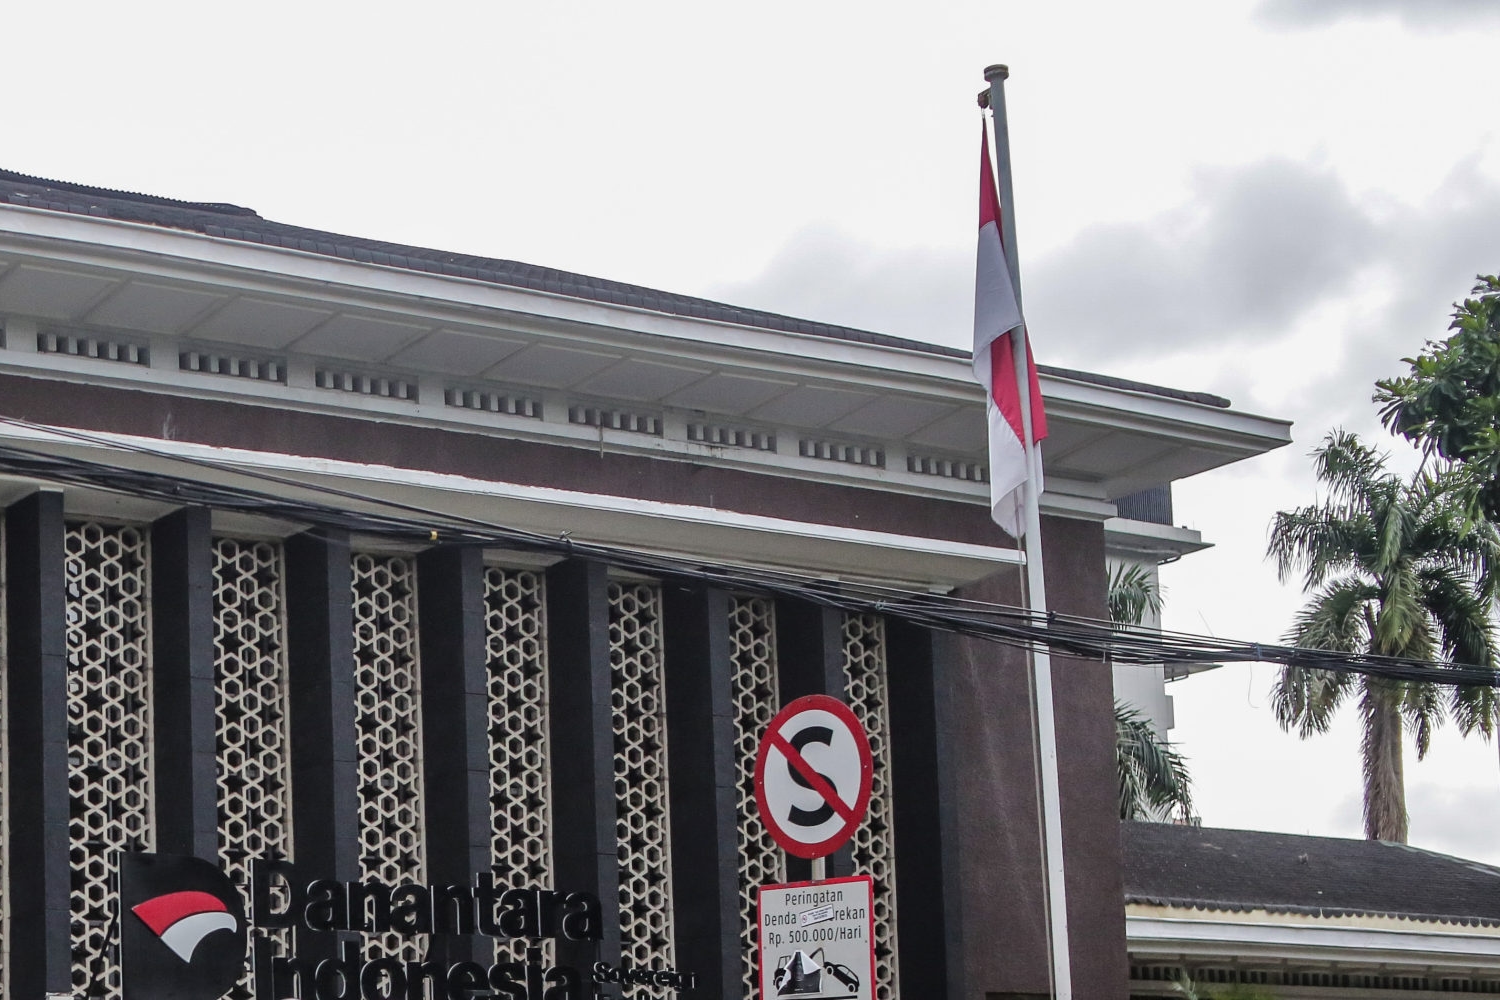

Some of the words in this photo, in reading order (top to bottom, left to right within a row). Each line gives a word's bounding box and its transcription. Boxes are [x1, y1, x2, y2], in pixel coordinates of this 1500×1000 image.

[250, 858, 604, 942] Danantara
[785, 890, 844, 908] Peringatan
[764, 911, 797, 927] Denda
[768, 932, 785, 948] Rp.
[789, 925, 862, 944] 500.000/Hari
[592, 960, 699, 993] Sovereign
